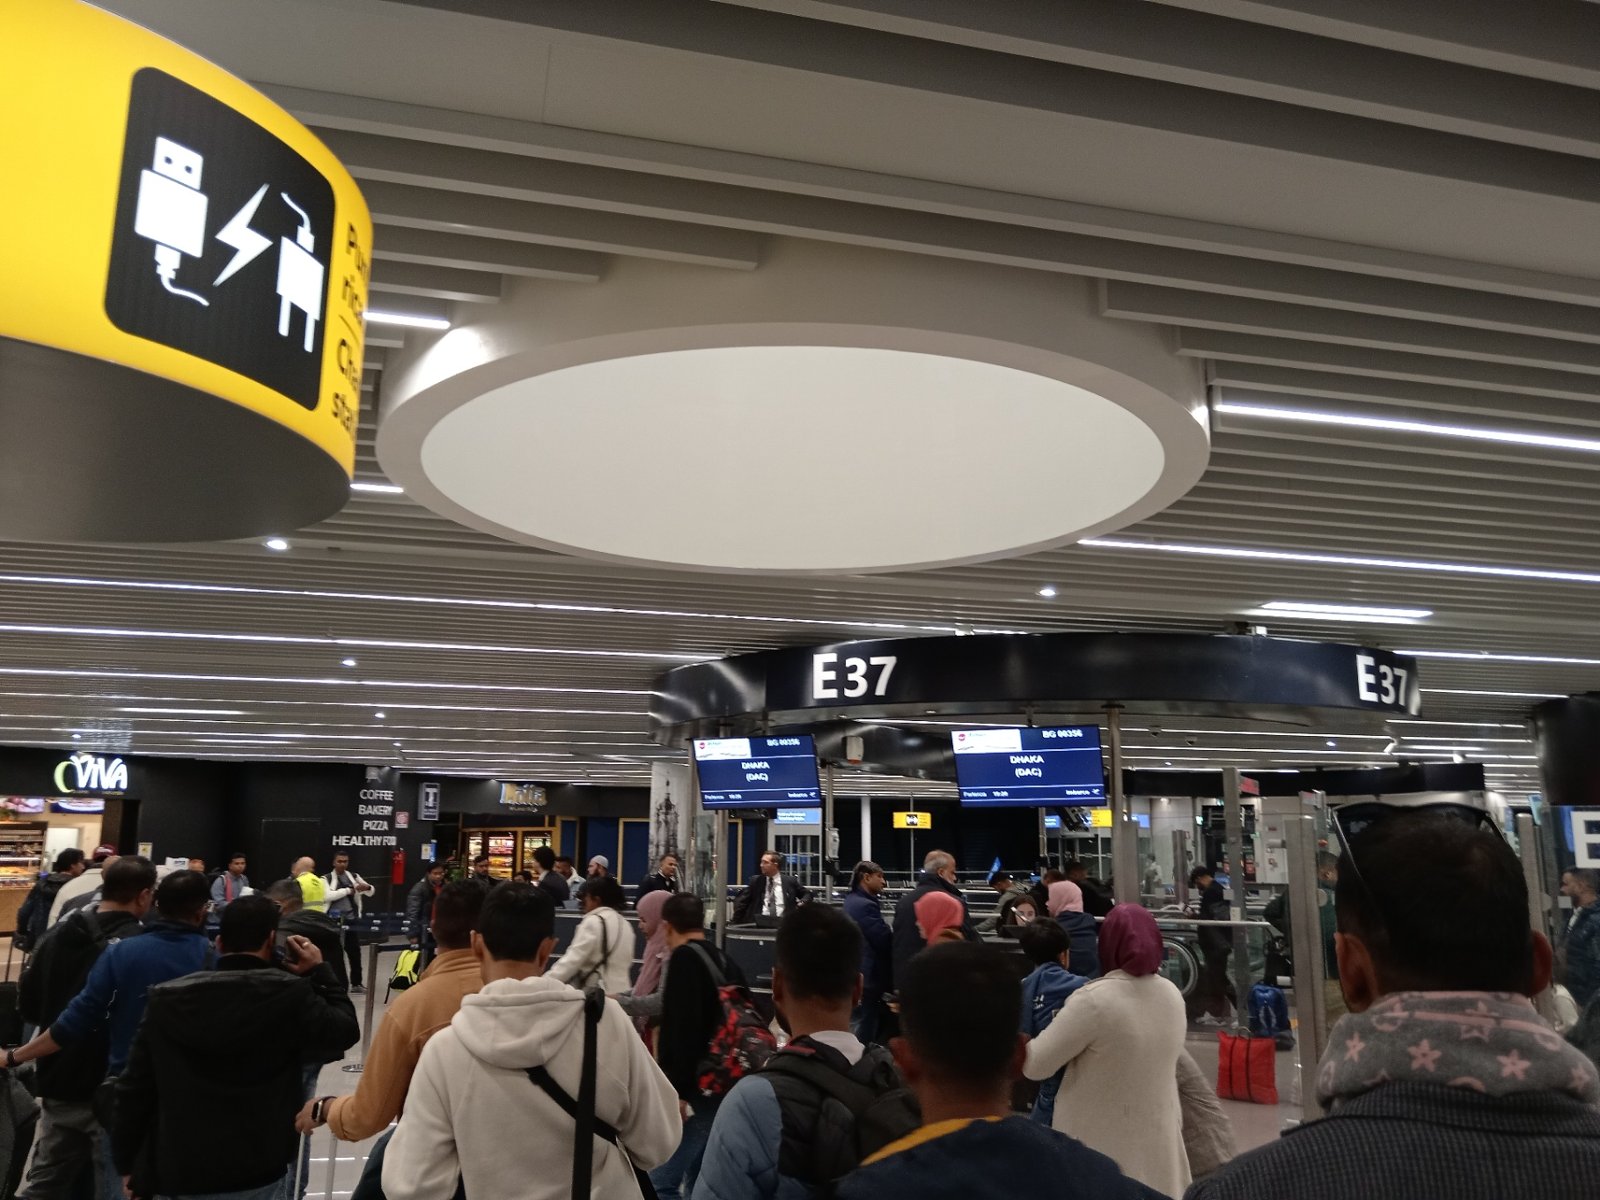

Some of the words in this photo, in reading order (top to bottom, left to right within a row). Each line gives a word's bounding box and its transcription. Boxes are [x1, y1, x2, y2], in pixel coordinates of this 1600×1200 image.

[813, 653, 897, 700] E37
[1356, 654, 1407, 706] E37
[1009, 755, 1045, 764] DHAKA
[1014, 767, 1042, 778] (DAC)
[359, 789, 394, 801] COFFEE
[358, 804, 393, 816] BAKERY
[362, 819, 389, 831] PIZZA
[332, 834, 382, 846] HEALTHY
